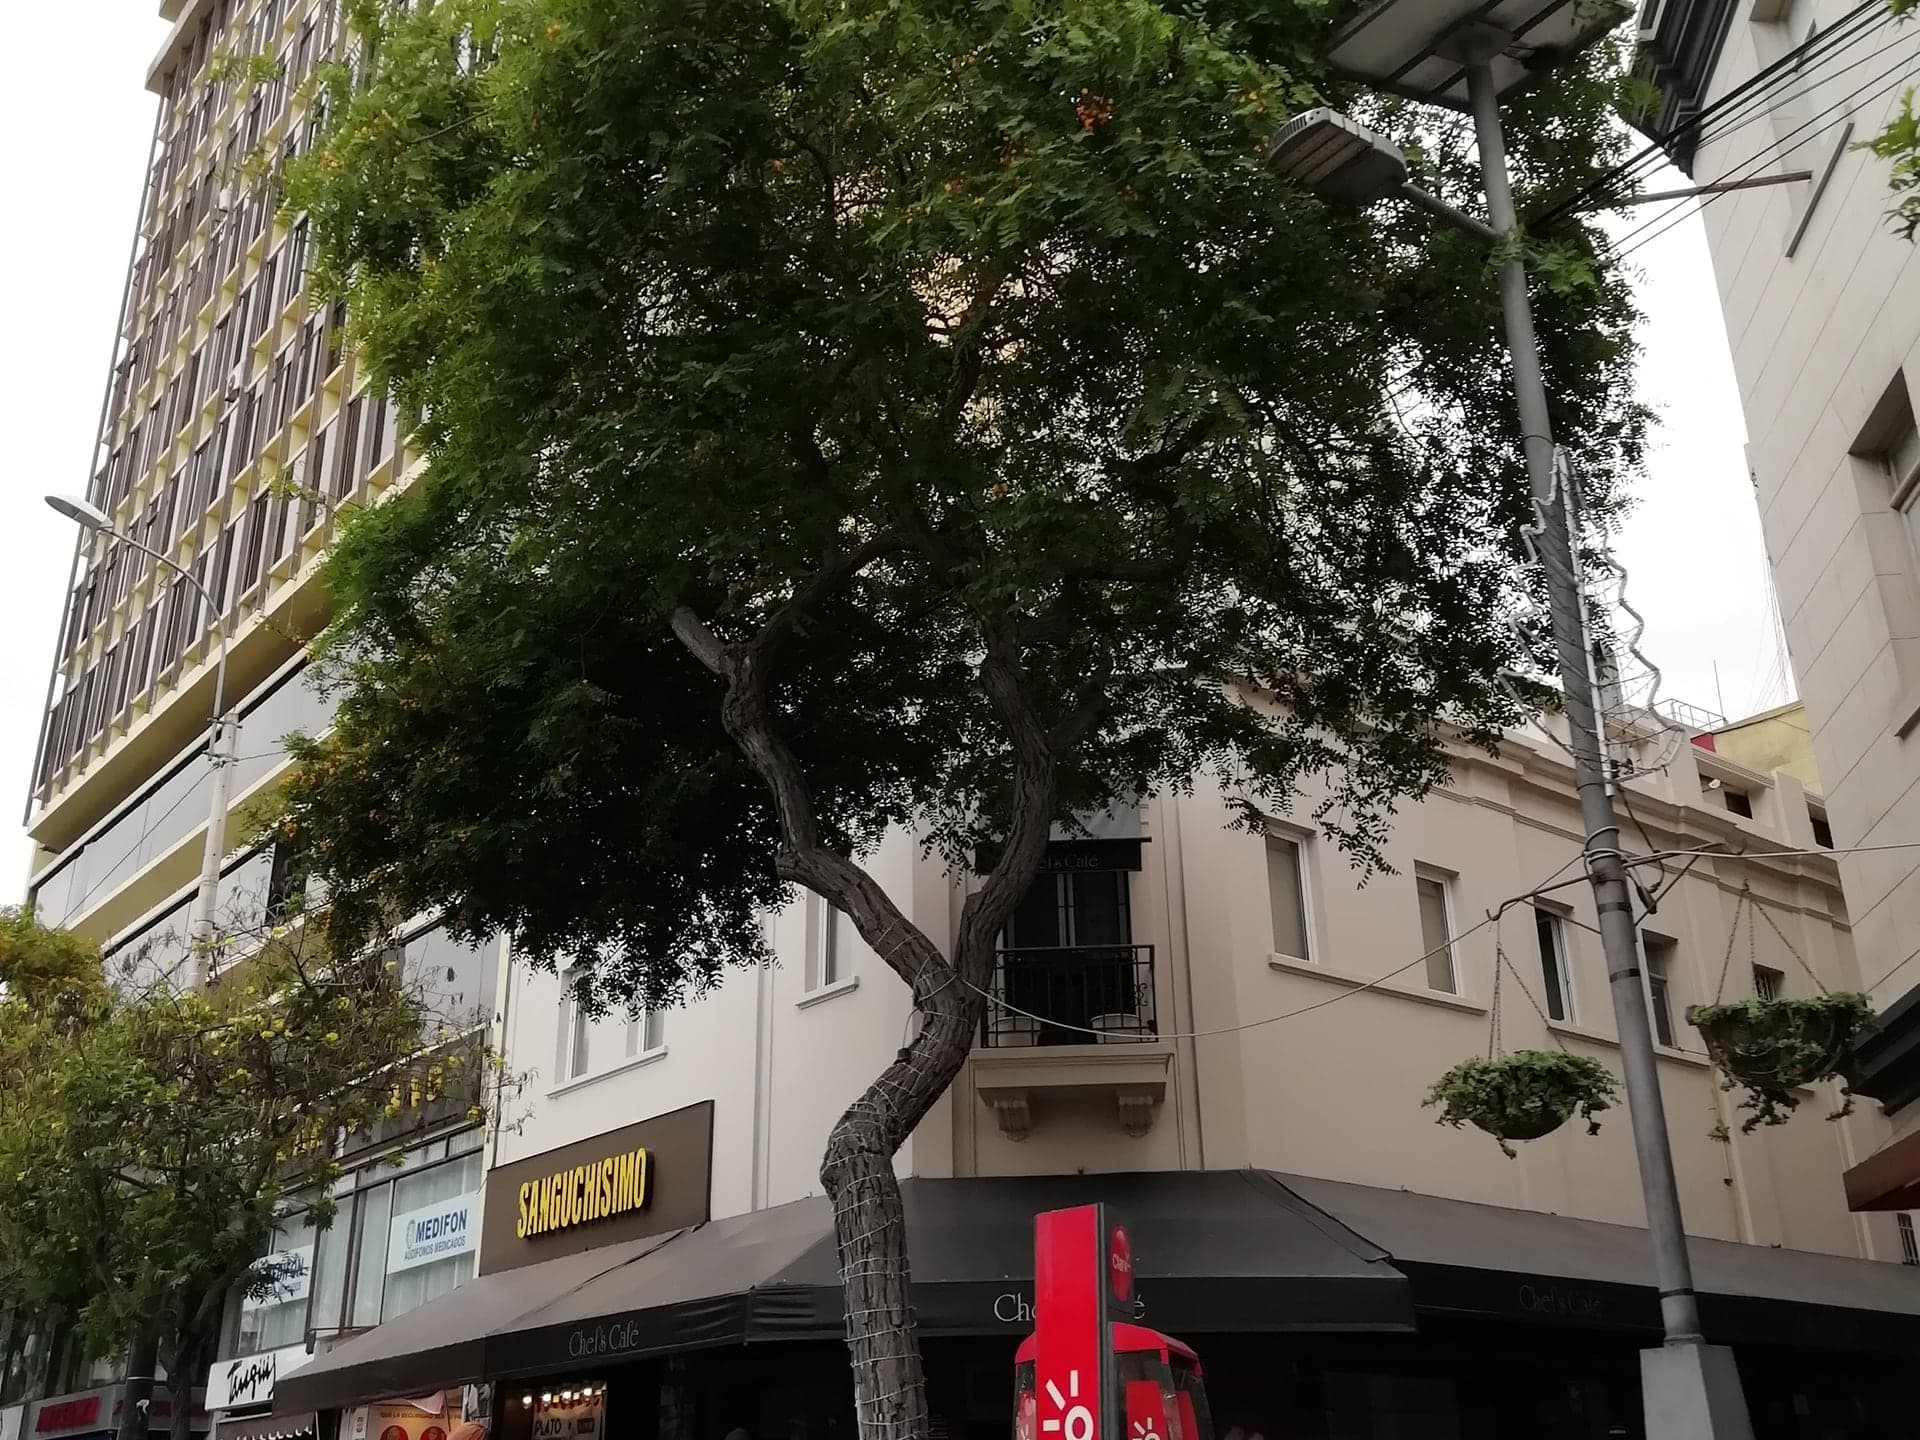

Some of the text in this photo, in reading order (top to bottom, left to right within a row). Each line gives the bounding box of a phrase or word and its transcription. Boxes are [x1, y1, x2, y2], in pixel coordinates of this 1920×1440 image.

[517, 1147, 648, 1239] SANGUCHISIMO
[415, 1208, 468, 1244] MEDIFON
[568, 1319, 640, 1358] Chef's Café
